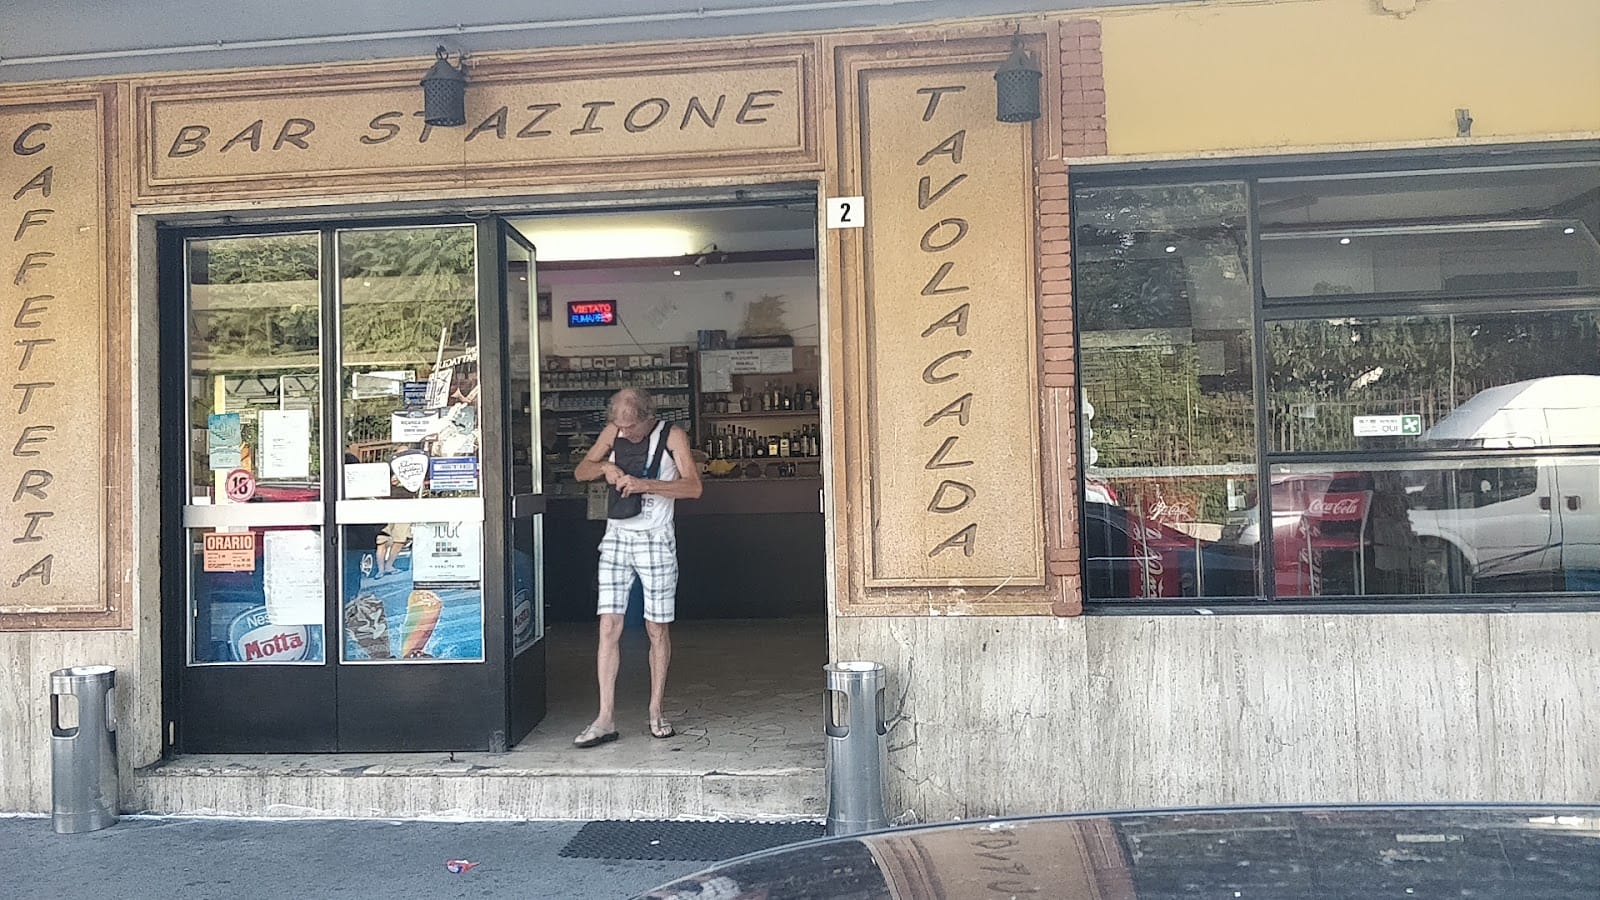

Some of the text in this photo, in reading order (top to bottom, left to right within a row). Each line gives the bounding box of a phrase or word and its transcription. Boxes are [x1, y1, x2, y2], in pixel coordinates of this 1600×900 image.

[168, 118, 316, 158] BAR
[840, 202, 851, 222] 2
[572, 304, 611, 313] VIETATO
[12, 122, 55, 588] CAFFETTERIA
[206, 535, 253, 550] ORARIO
[244, 632, 304, 661] Motta
